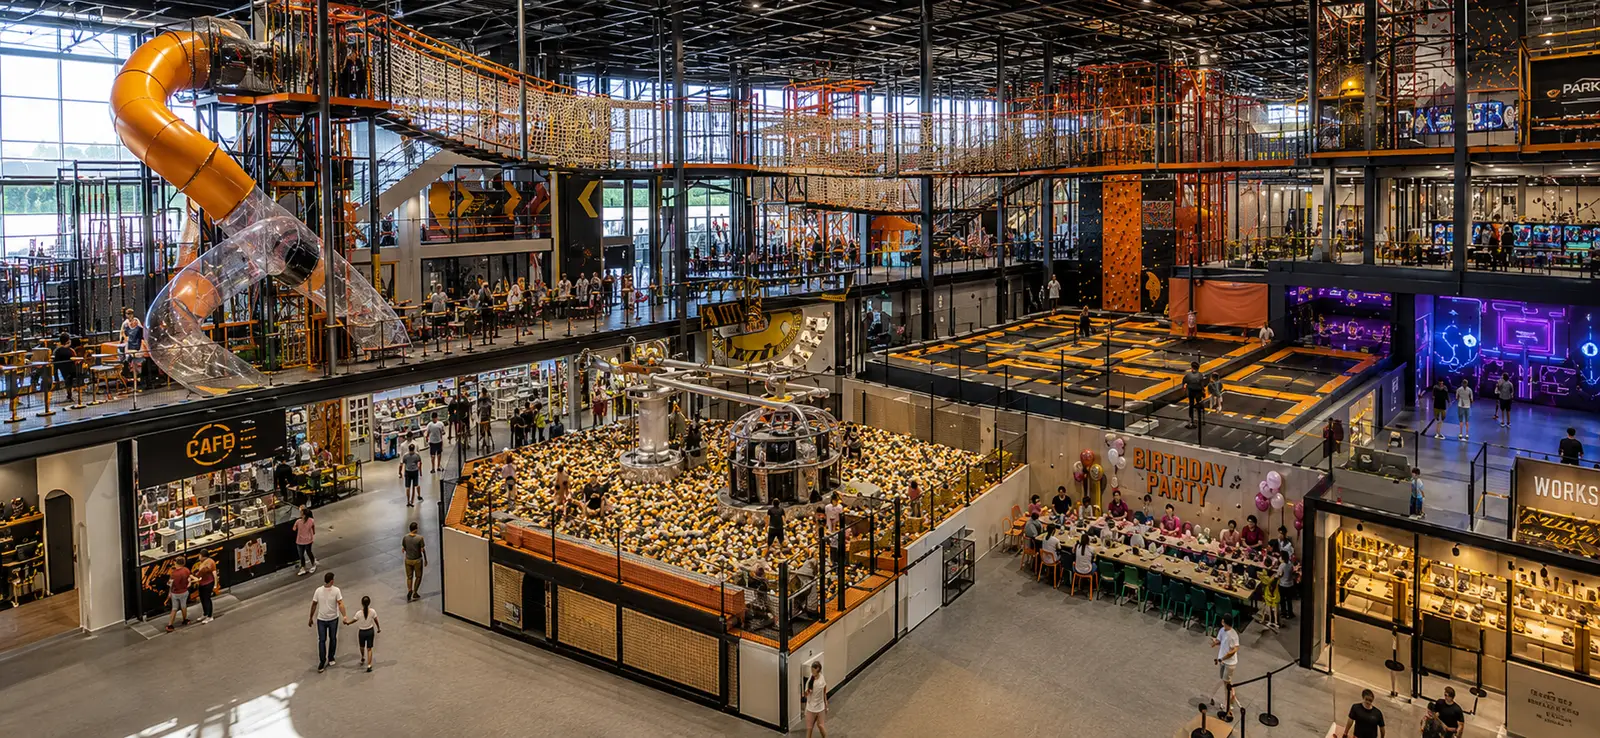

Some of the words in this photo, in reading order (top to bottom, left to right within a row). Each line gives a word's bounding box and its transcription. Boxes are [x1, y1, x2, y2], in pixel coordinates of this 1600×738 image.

[1563, 81, 1600, 94] PARK
[186, 432, 235, 458] CAFE
[1133, 447, 1227, 487] BIRTHDAY
[1147, 472, 1208, 507] PARTY
[1534, 475, 1599, 506] WORKS
